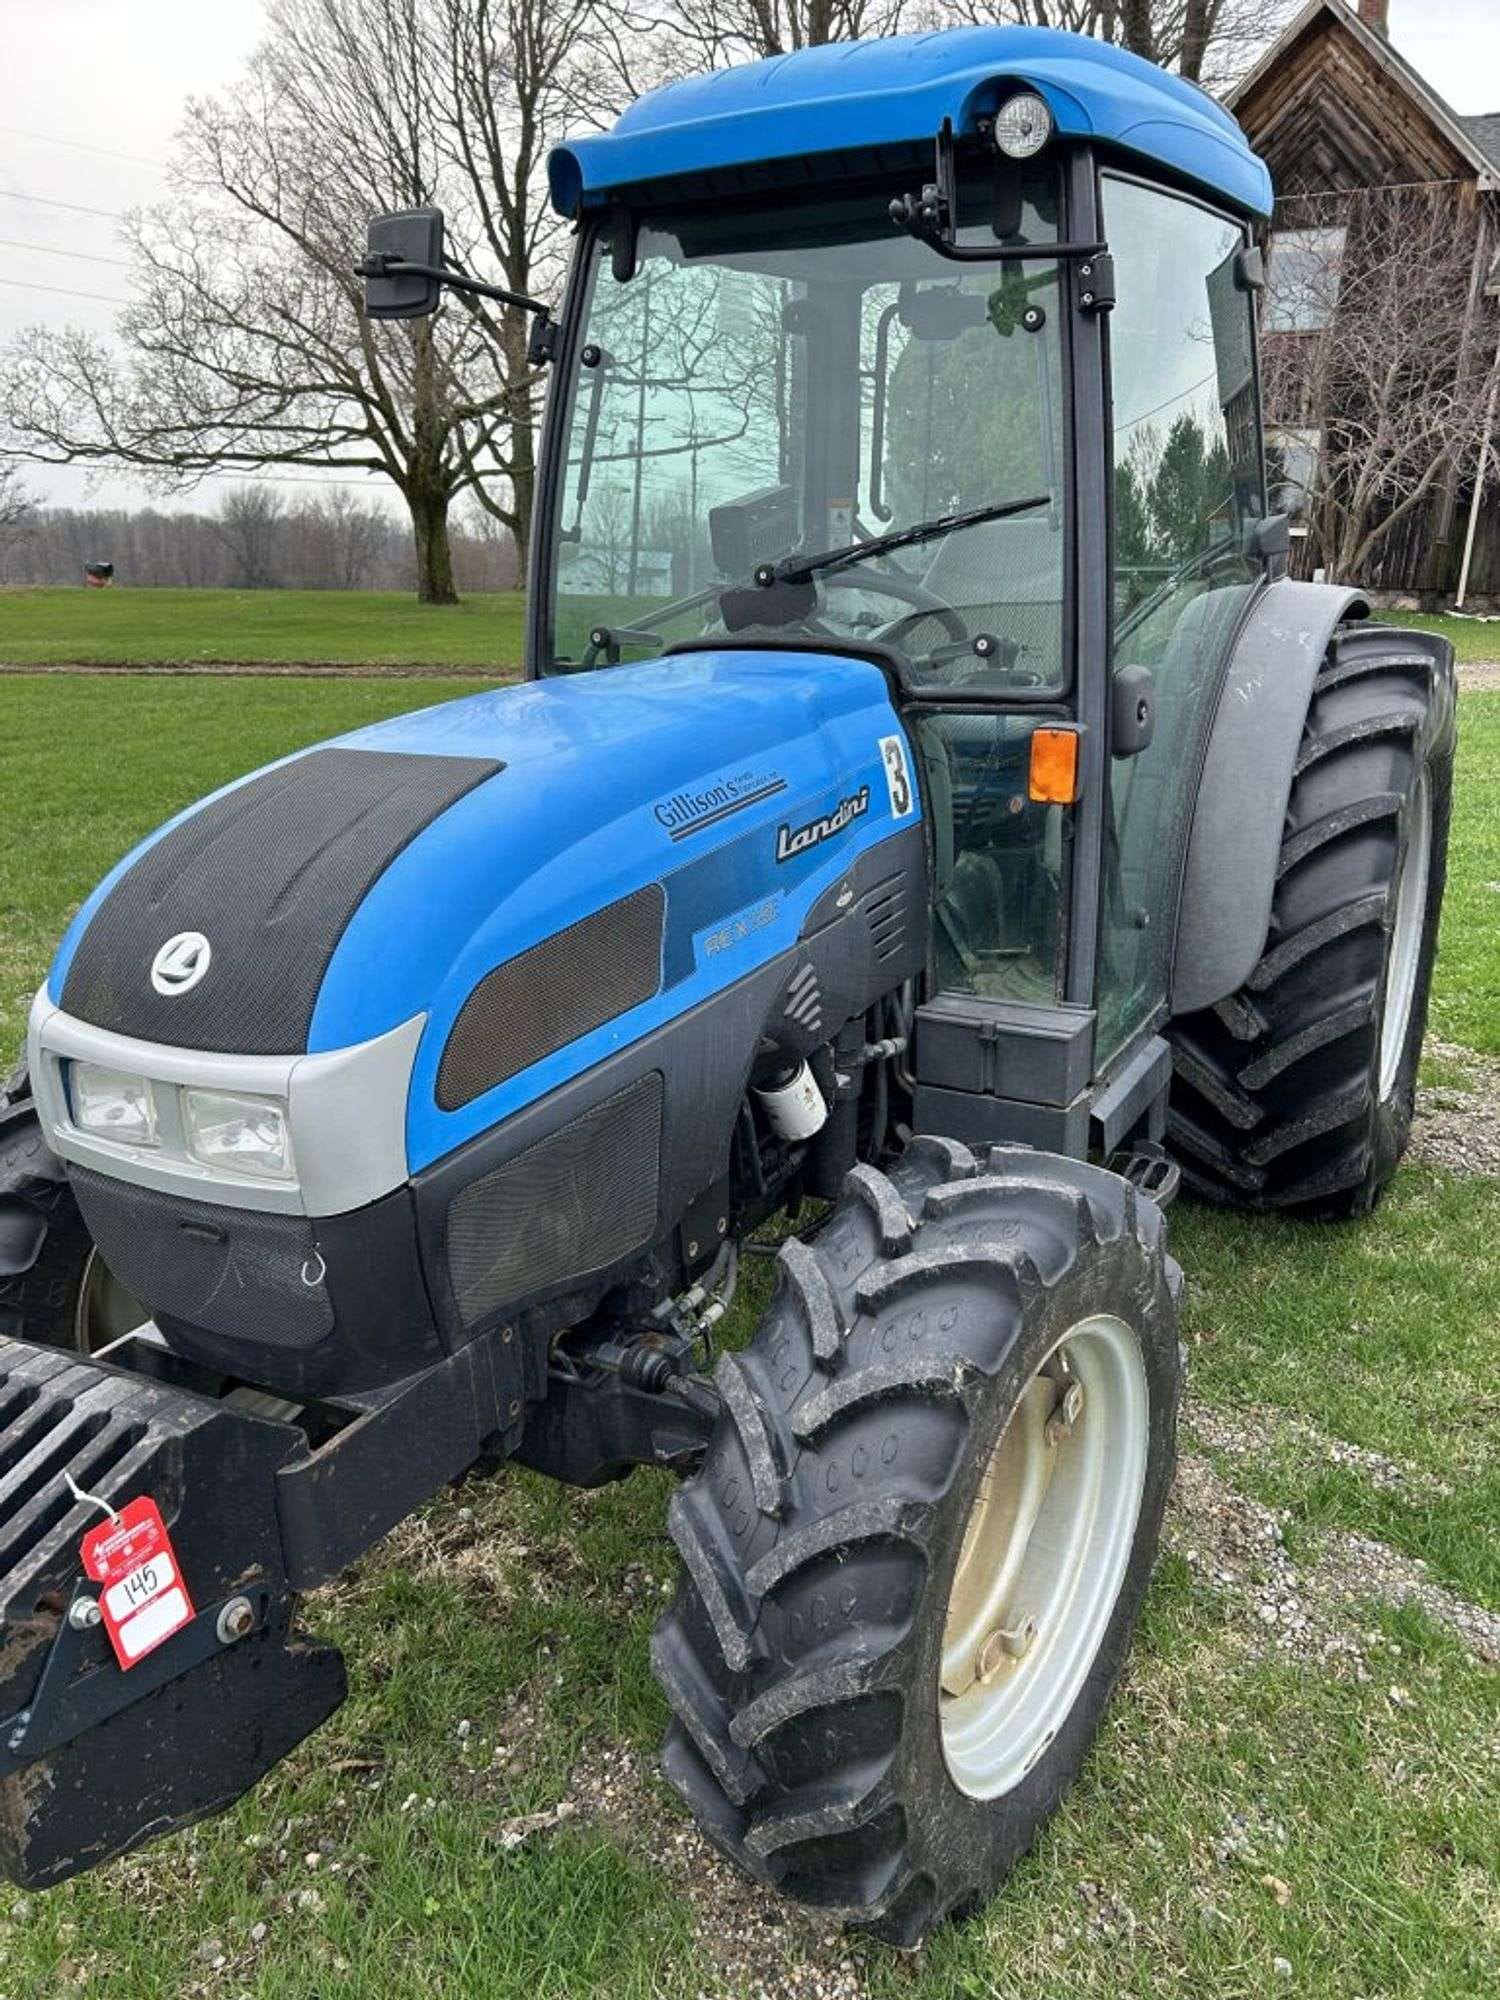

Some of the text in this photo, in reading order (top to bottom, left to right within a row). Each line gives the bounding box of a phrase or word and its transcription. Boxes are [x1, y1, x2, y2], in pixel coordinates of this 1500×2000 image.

[654, 778, 740, 828] Gillison's
[884, 739, 909, 815] 3
[776, 786, 869, 861] Landini
[123, 1565, 158, 1606] 145
